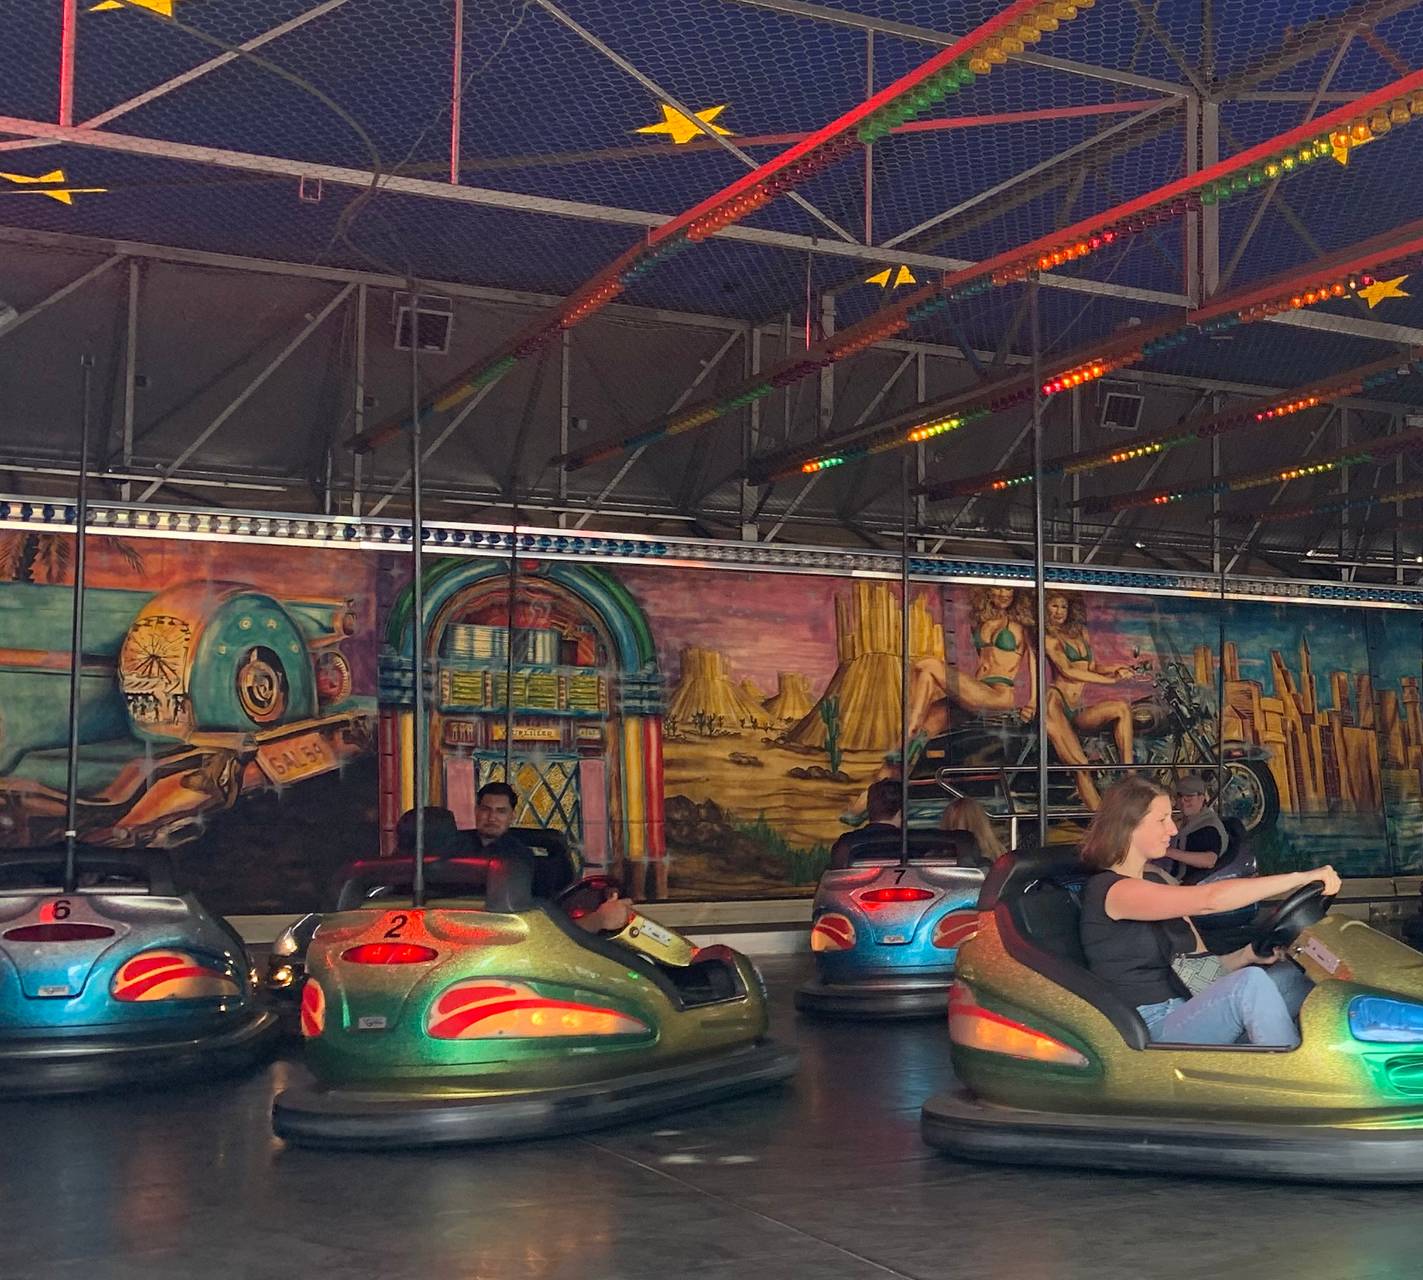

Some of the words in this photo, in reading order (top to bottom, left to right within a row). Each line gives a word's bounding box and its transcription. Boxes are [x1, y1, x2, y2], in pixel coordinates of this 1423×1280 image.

[894, 869, 906, 885] 7
[52, 899, 71, 920] 6
[384, 914, 408, 939] 2
